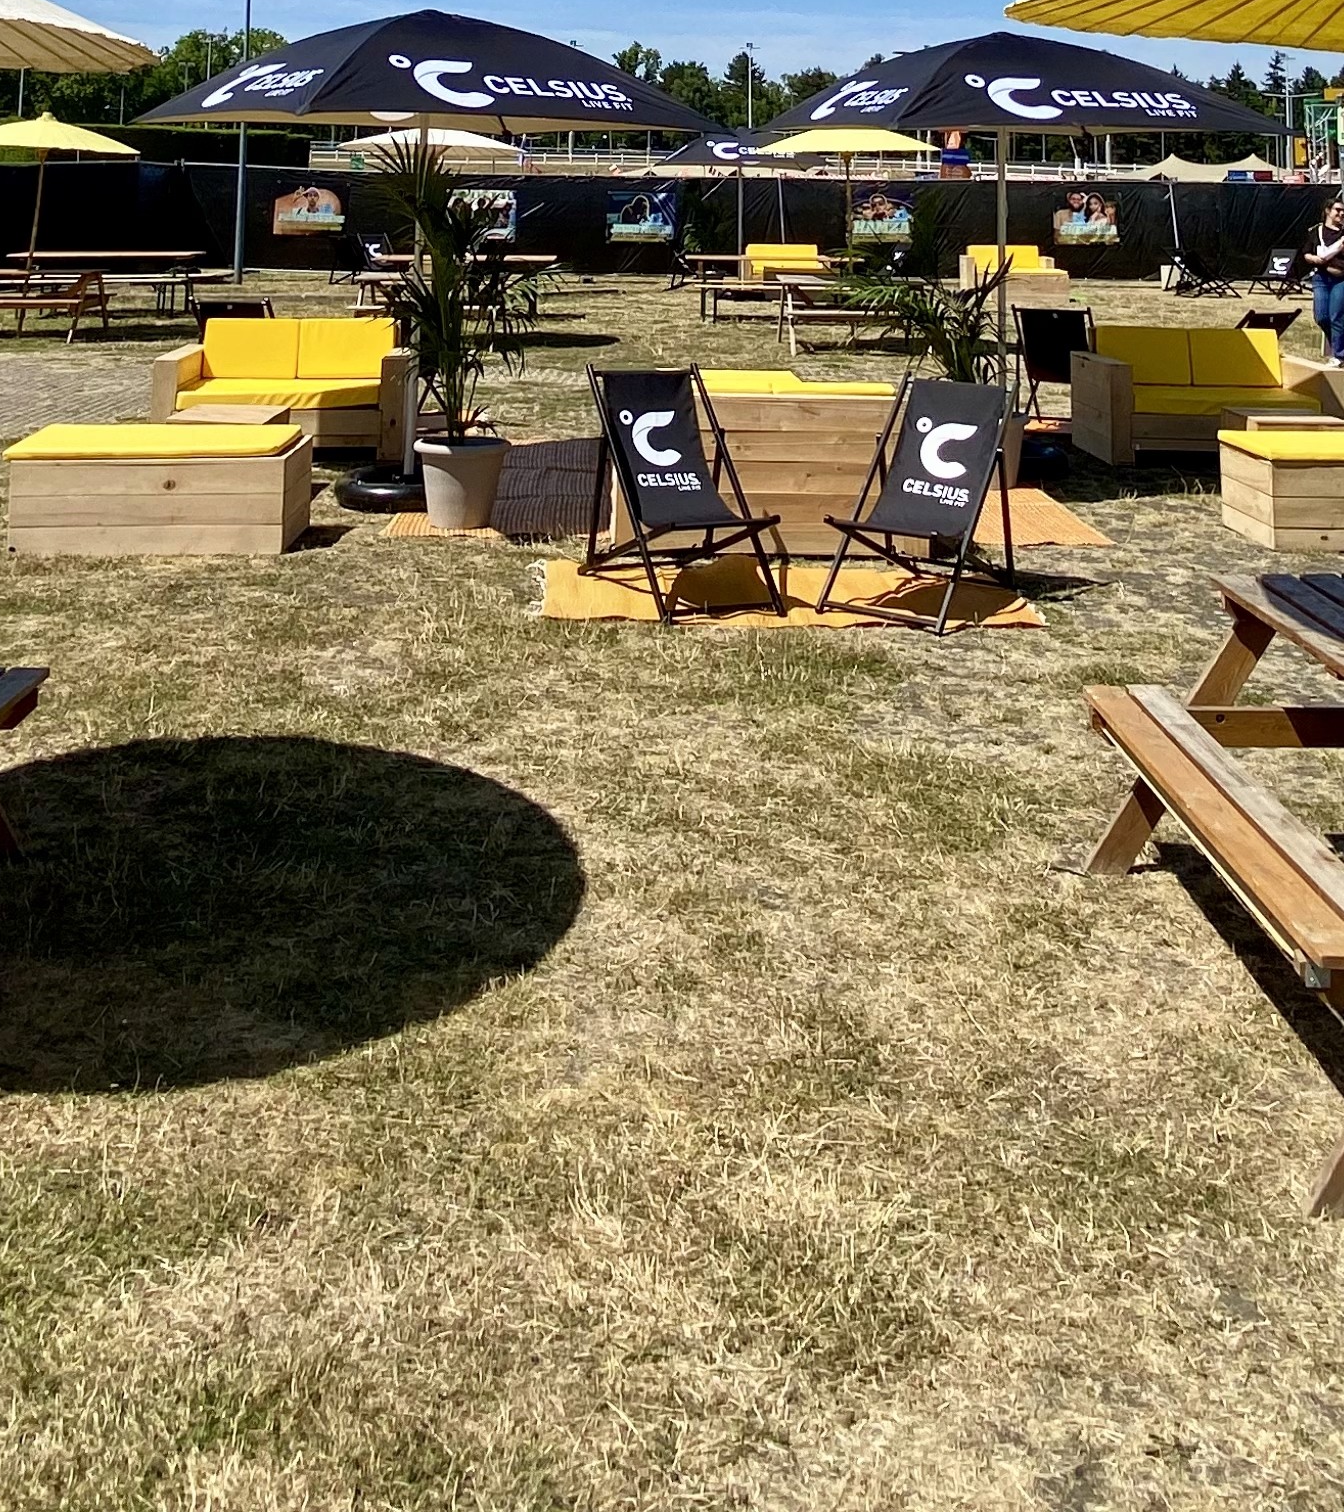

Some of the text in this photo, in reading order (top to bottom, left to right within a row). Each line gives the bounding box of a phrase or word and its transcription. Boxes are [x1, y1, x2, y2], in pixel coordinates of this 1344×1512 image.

[581, 99, 633, 112] LIVE FIT
[1145, 108, 1198, 119] LIVE FIT
